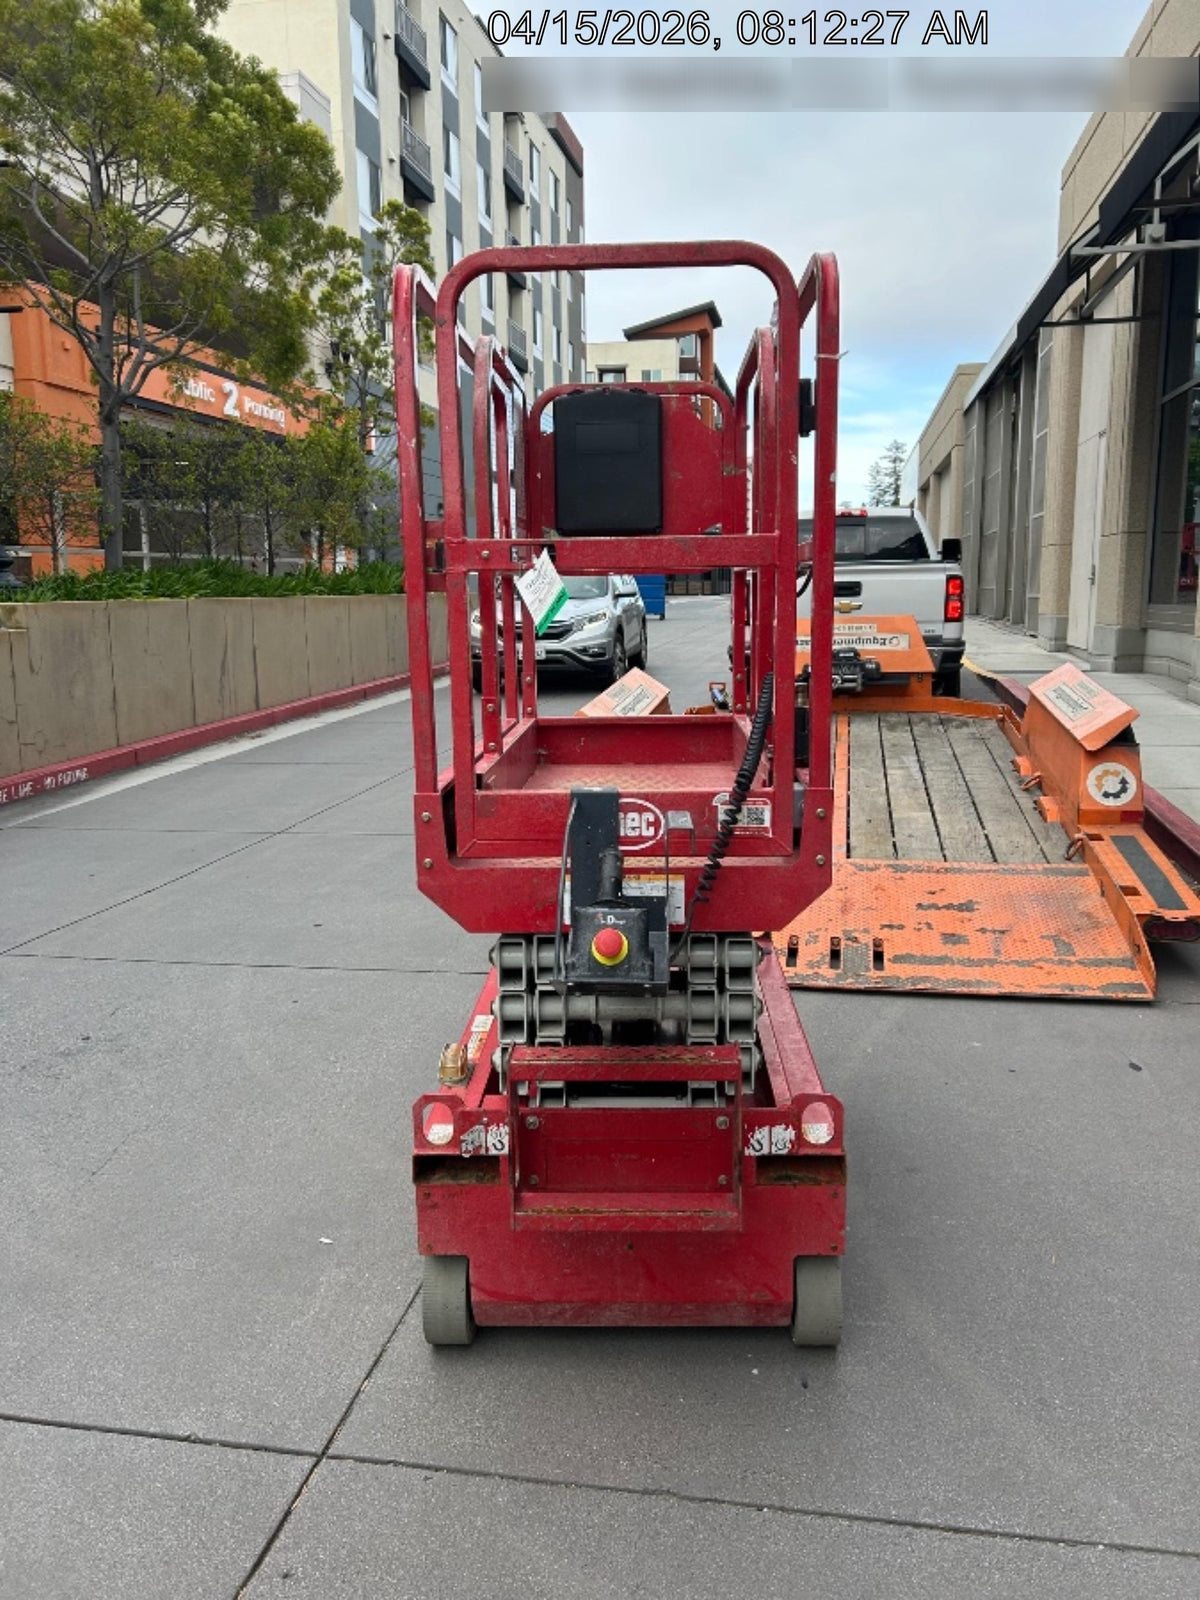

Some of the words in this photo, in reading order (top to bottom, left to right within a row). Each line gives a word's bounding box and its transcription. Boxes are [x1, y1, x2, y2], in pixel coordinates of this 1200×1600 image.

[222, 381, 240, 418] 2
[833, 636, 888, 646] Equipme
[619, 812, 655, 837] ec
